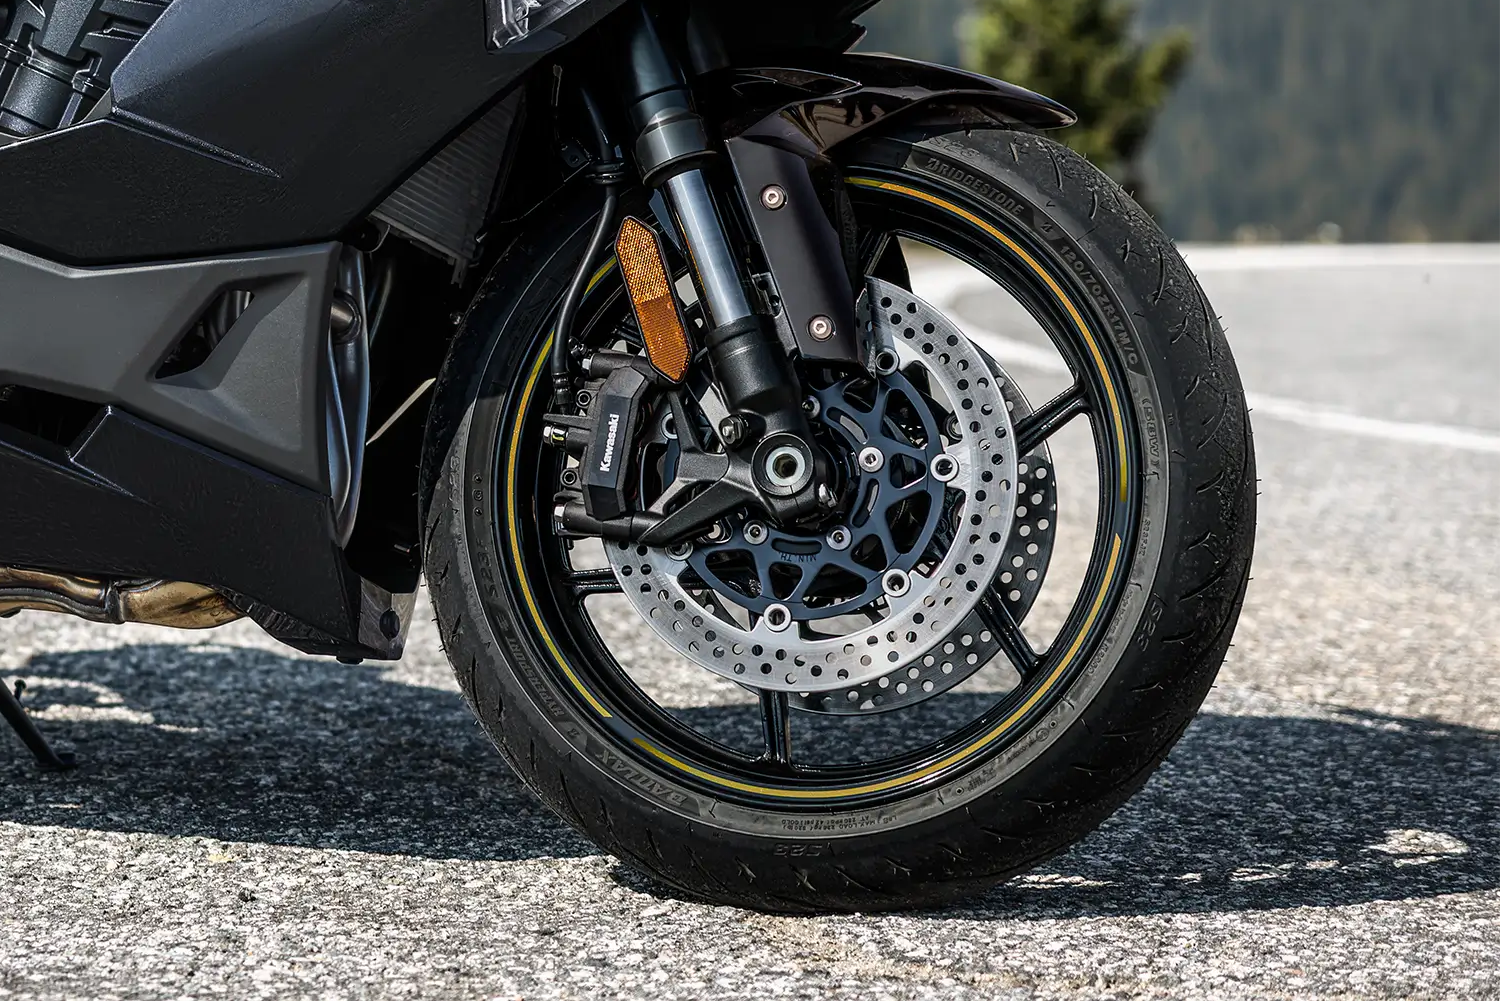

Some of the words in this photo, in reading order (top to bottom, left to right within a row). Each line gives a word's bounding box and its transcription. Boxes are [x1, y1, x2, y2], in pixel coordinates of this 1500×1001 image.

[927, 157, 1024, 216] BRIDGESTONE
[600, 413, 620, 472] Kawasaki
[601, 750, 687, 806] BATTLAX
